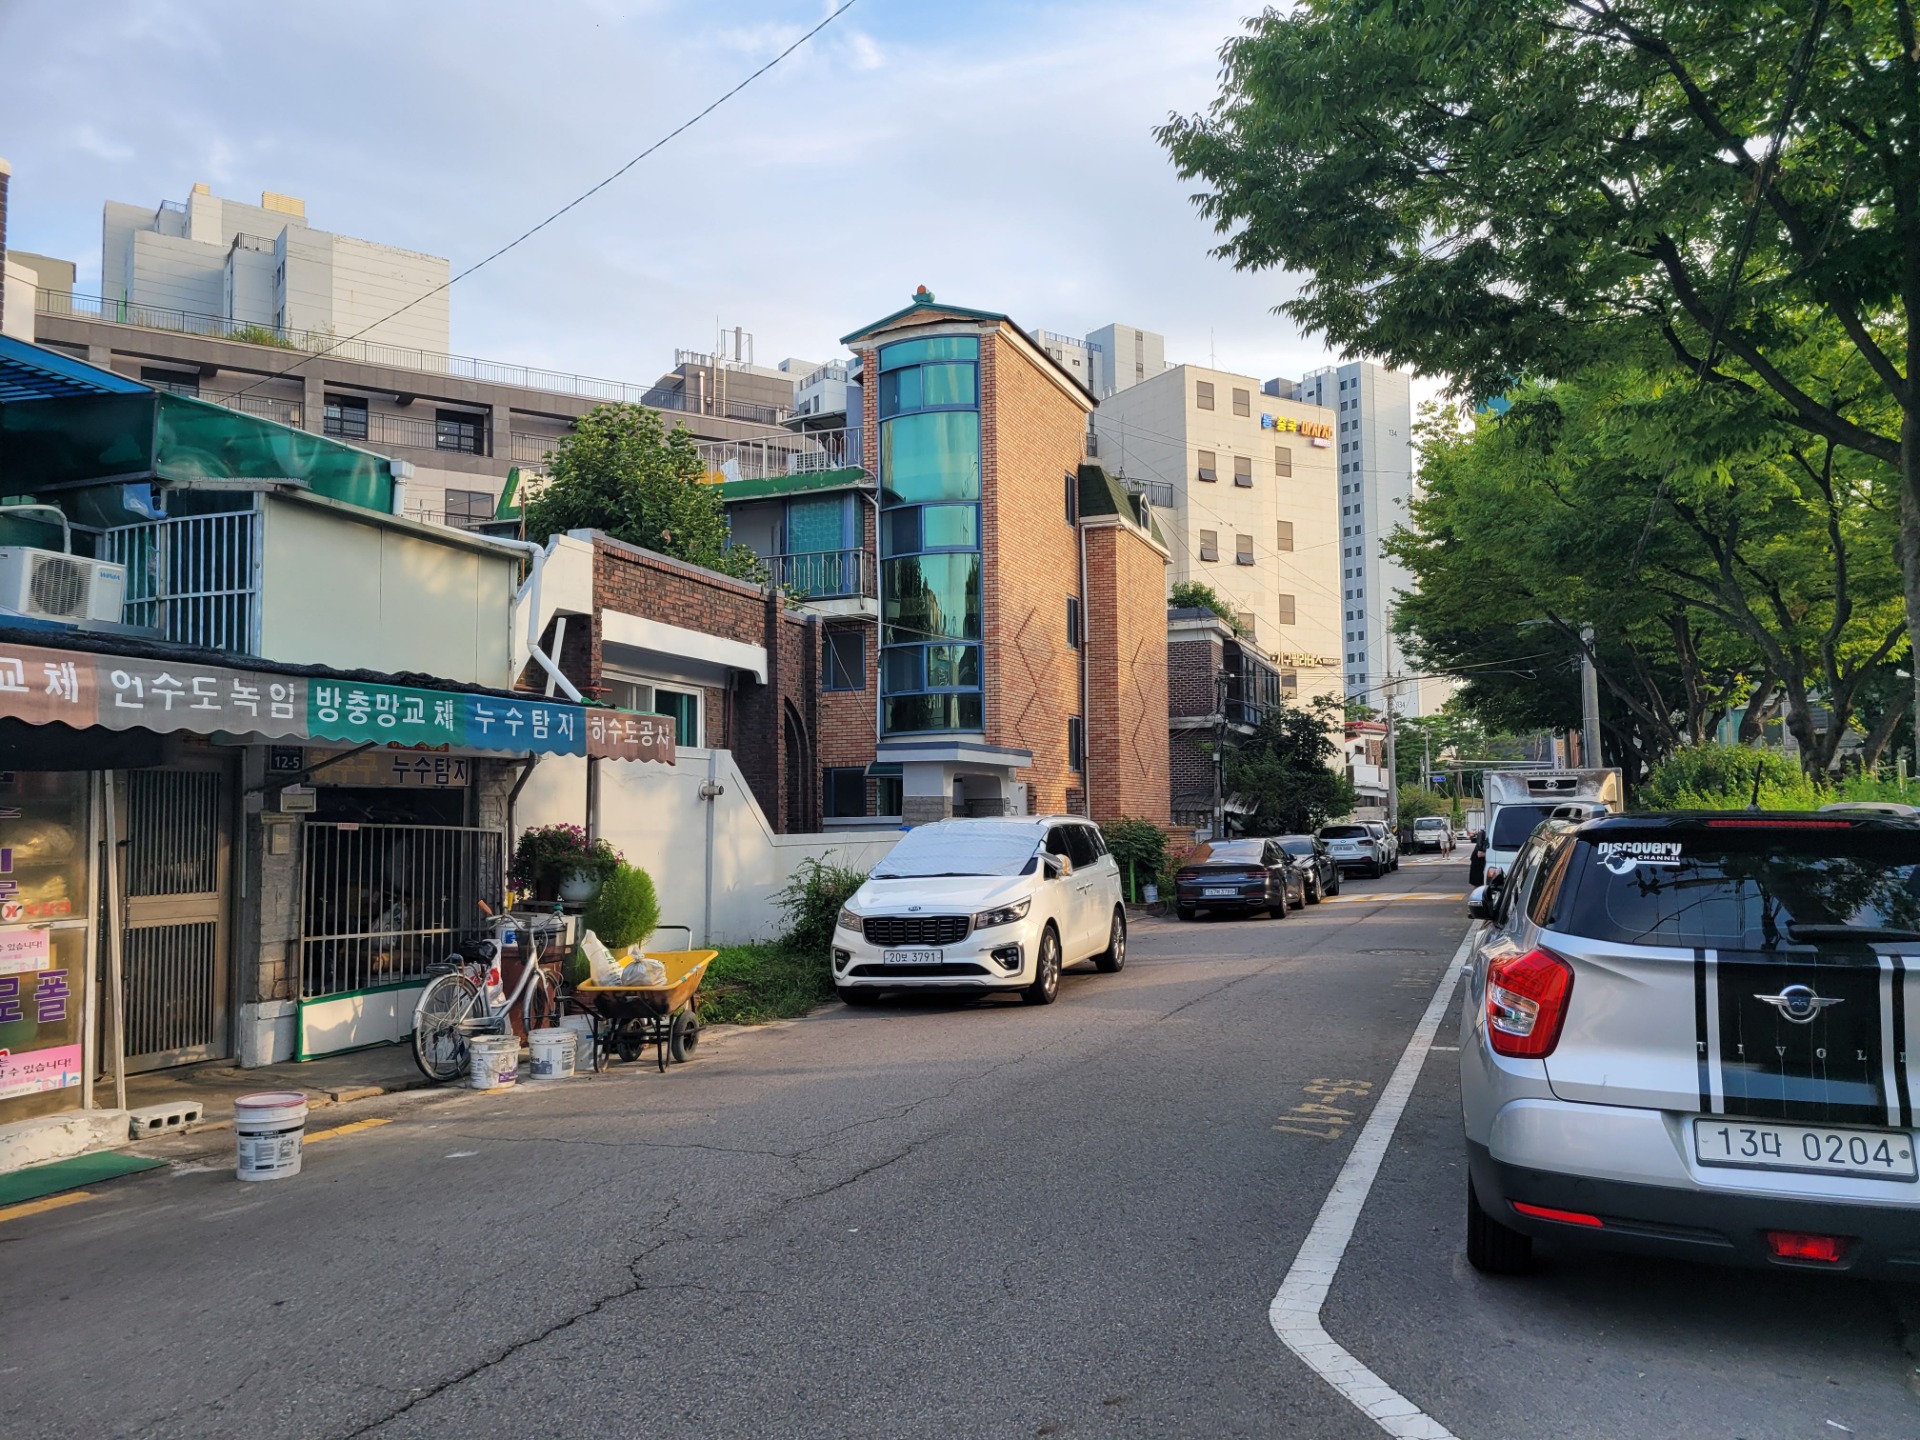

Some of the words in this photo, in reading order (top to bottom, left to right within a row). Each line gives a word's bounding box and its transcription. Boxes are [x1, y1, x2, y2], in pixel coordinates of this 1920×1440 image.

[1276, 416, 1297, 433] 중국
[474, 703, 574, 742] 누수탐지
[591, 716, 670, 750] 하수도공사
[275, 756, 300, 769] 12-5
[391, 755, 469, 786] 누수탐지
[912, 952, 935, 962] 3791
[23, 1058, 72, 1074] 있습니다!
[1718, 1127, 1782, 1158] 13다
[1802, 1132, 1894, 1168] 0204
